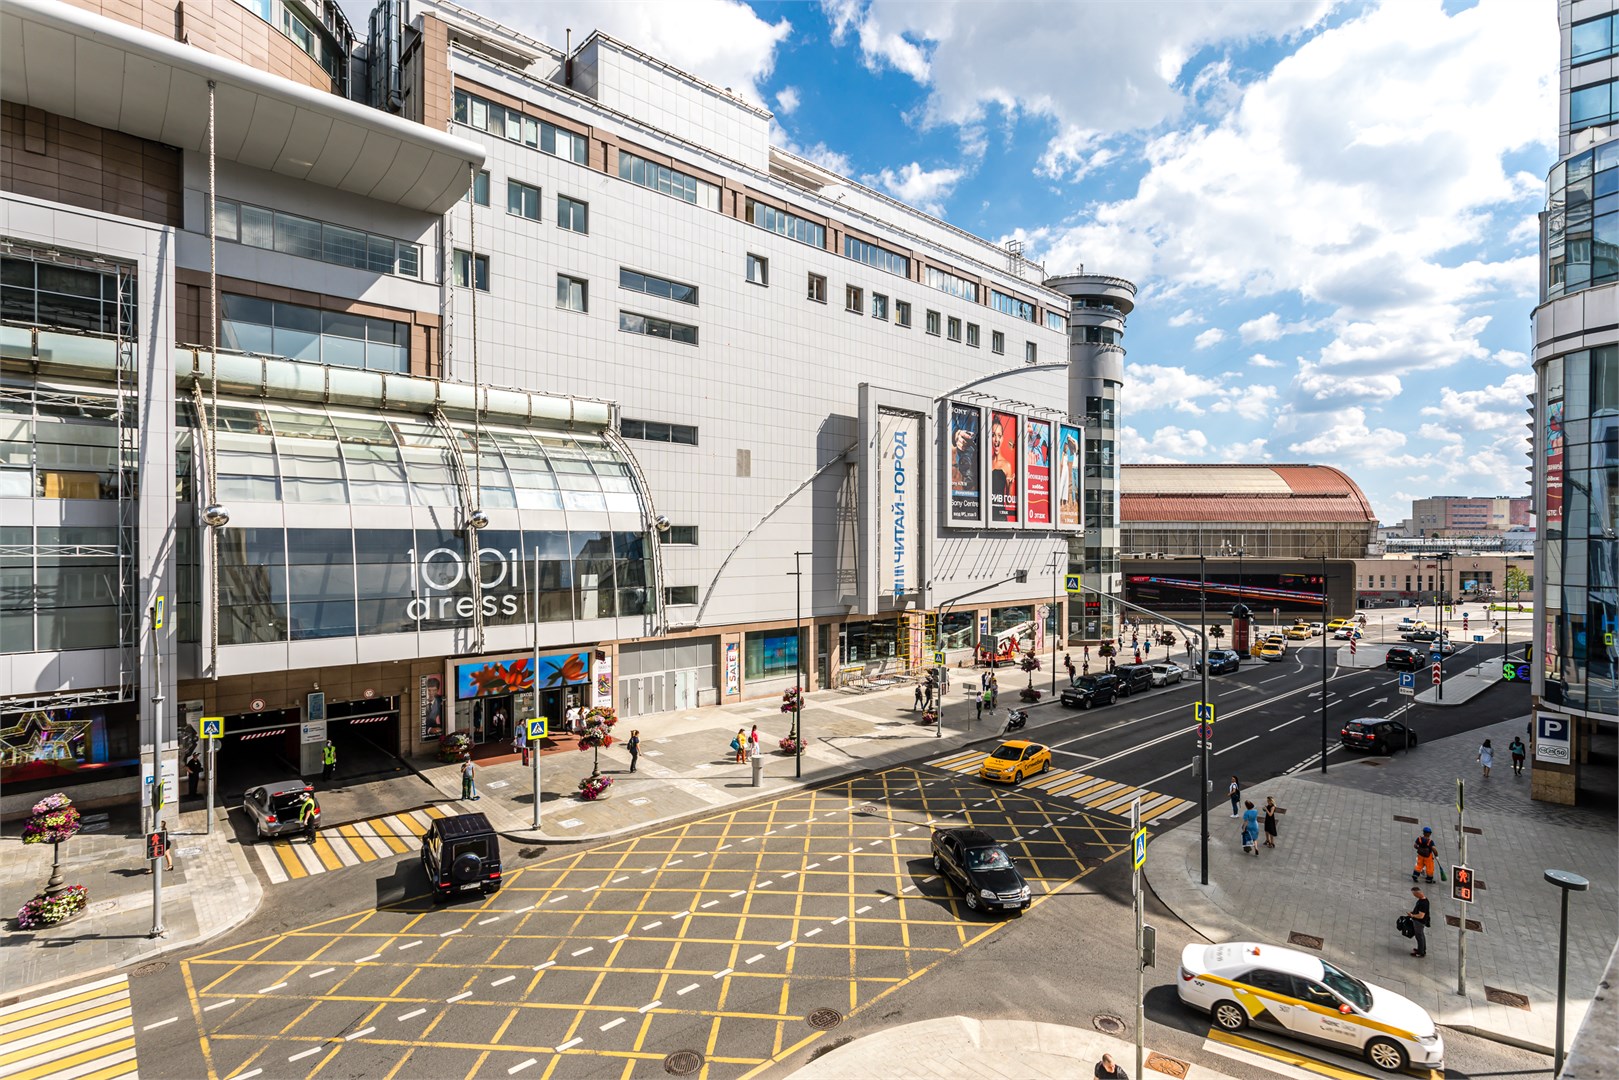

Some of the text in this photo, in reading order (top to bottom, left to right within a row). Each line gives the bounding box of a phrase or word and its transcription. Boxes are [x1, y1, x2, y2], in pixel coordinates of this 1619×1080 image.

[891, 431, 907, 563] ЧИТАЙ-ГОРОД
[951, 499, 963, 508] Sony
[407, 547, 517, 591] 1001
[406, 588, 518, 620] dress
[1403, 674, 1411, 685] P
[1544, 719, 1562, 736] P
